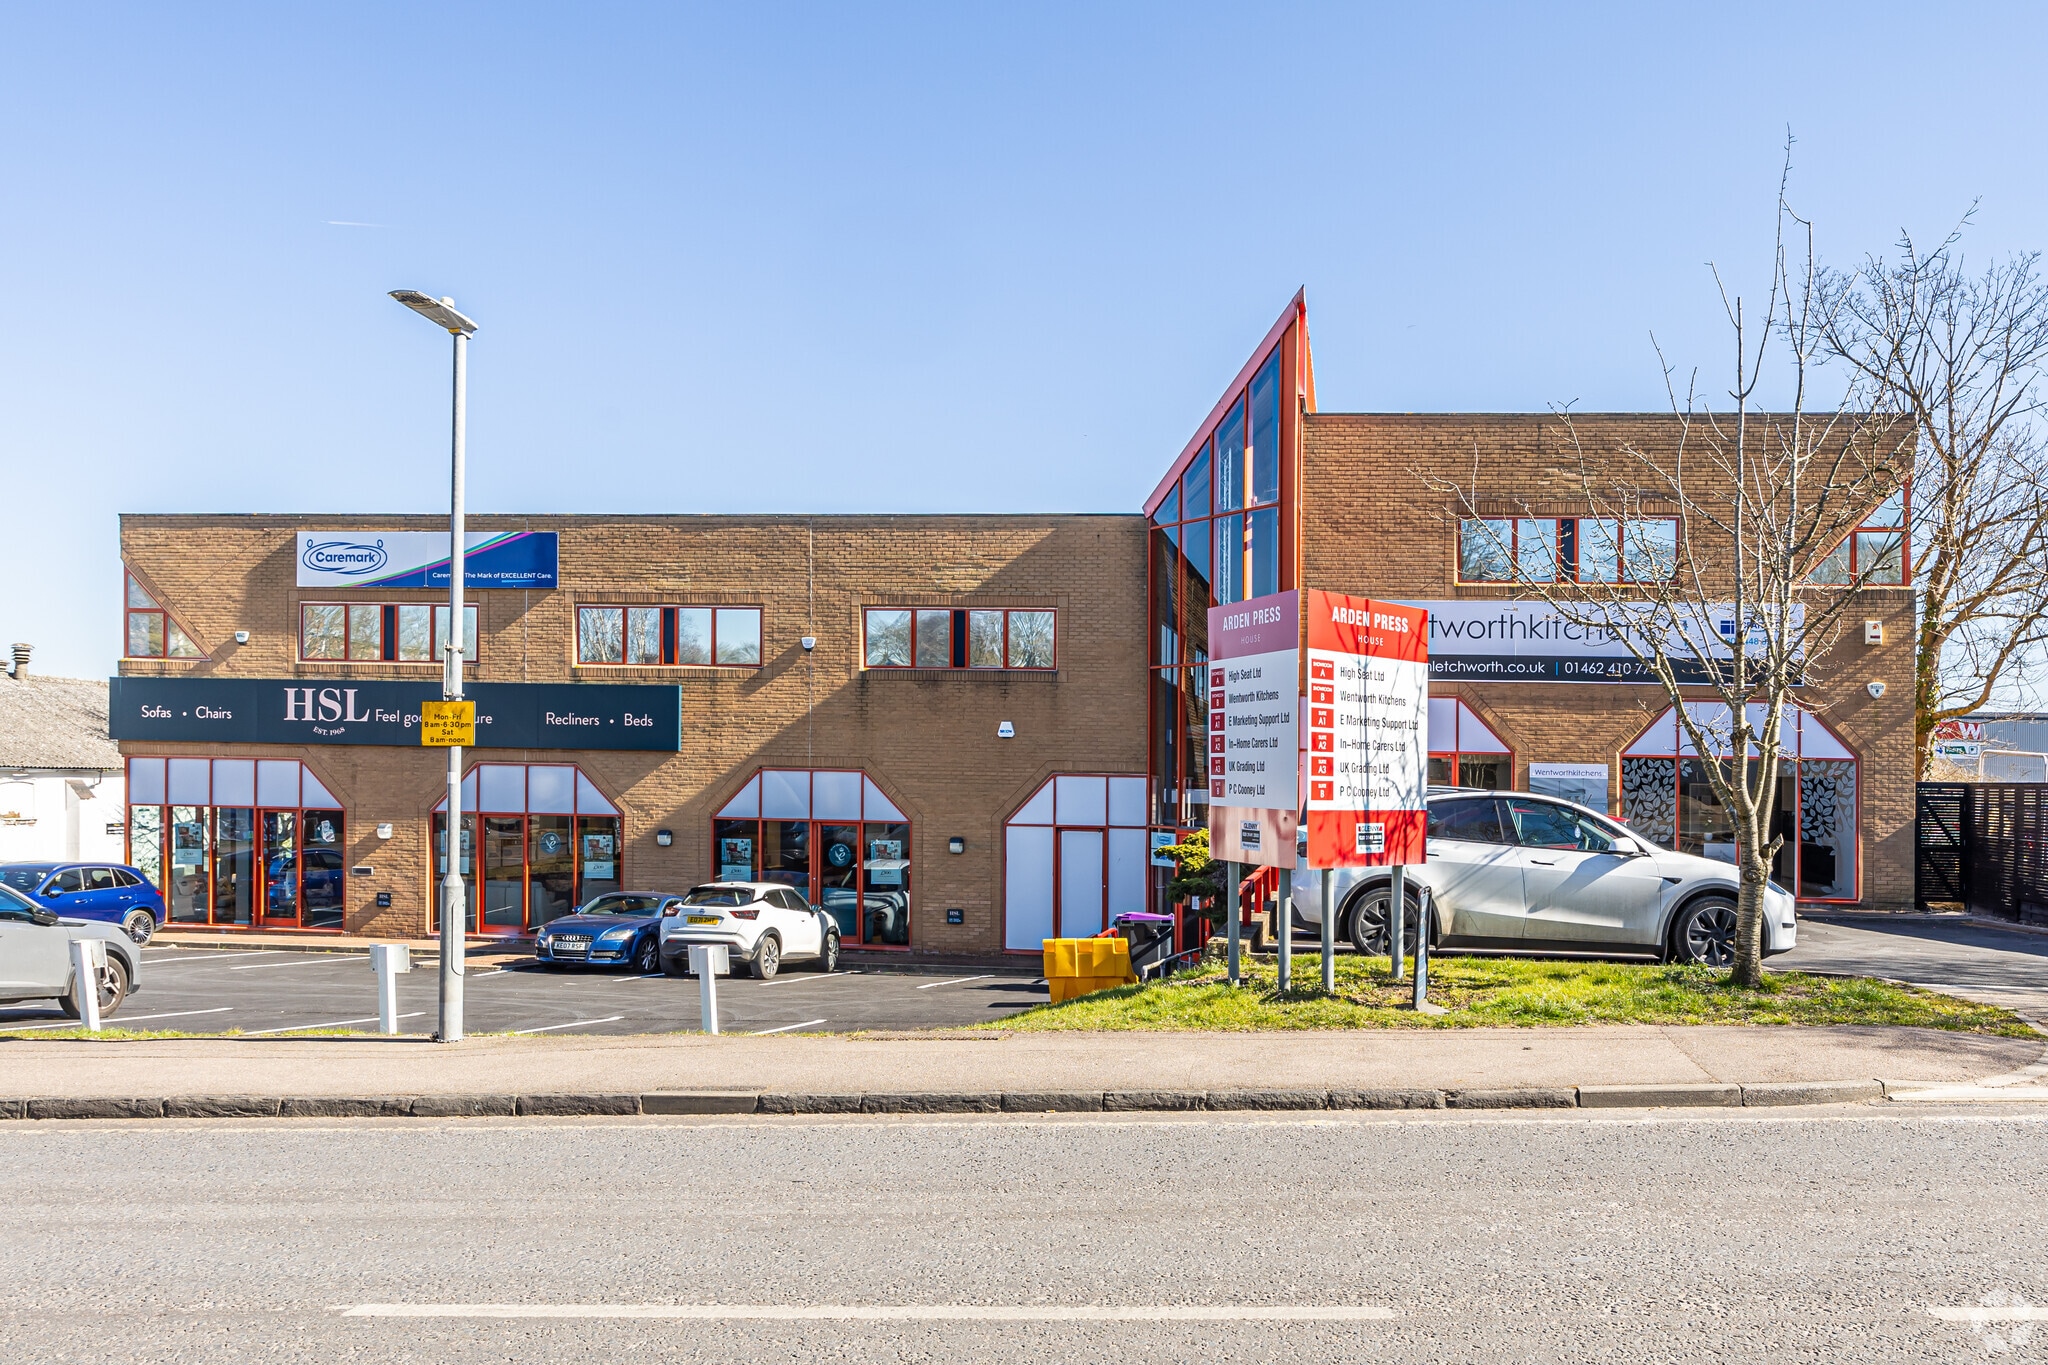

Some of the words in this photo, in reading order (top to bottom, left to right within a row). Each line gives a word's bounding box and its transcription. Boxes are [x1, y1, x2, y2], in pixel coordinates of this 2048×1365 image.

[316, 552, 375, 562] Caremark
[1223, 612, 1250, 631] ARDEN
[1253, 606, 1280, 626] PRESS
[1332, 606, 1370, 627] ARDEN
[1374, 613, 1408, 633] PRESS
[1241, 633, 1261, 644] HOUSE
[1358, 634, 1384, 646] HOUSE
[1320, 669, 1325, 677] A
[1340, 667, 1355, 680] High
[1358, 669, 1372, 680] Seat
[1374, 671, 1384, 681] Ltd
[1564, 662, 1604, 674] 01462
[1608, 662, 1631, 674] 410
[1229, 671, 1240, 683] High
[1241, 669, 1252, 680] Seat
[1253, 667, 1261, 678] Ltd
[1228, 692, 1255, 704] Wentworth
[1256, 690, 1279, 701] Kitchens
[1320, 693, 1325, 701] B
[1340, 691, 1376, 704] Wentworth
[1379, 694, 1406, 706] Kitchens
[284, 688, 370, 722] HSL
[141, 705, 172, 718] Sofas
[195, 706, 232, 719] Chairs
[375, 709, 400, 722] Feel
[546, 712, 600, 725] Recliners
[624, 713, 653, 726] Beds
[1229, 716, 1232, 726] E
[1233, 715, 1257, 727] Marketing
[1259, 713, 1280, 726] Support
[1281, 712, 1290, 723] Ltd
[1318, 717, 1326, 726] A1
[1340, 714, 1344, 725] E
[1346, 715, 1380, 729] Marketing
[1382, 717, 1407, 730] Support
[1409, 720, 1418, 730] Ltd
[313, 725, 328, 736] EST.
[330, 726, 345, 736] 1968
[1228, 738, 1250, 749] In-Home
[1252, 738, 1268, 748] Carers
[1270, 737, 1278, 748] Ltd
[1318, 741, 1326, 749] A2
[1340, 739, 1370, 750] In-Home
[1373, 740, 1394, 751] Carers
[1396, 741, 1406, 752] Ltd
[1229, 761, 1235, 772] UK
[1237, 761, 1255, 774] Grading
[1257, 761, 1265, 771] Ltd
[1318, 766, 1326, 774] A3
[1340, 762, 1349, 773] UK
[1352, 763, 1377, 776] Grading
[1379, 763, 1389, 774] Ltd
[1535, 769, 1602, 777] Wentworthkitchens
[1229, 784, 1232, 794] P
[1233, 784, 1237, 794] C
[1238, 784, 1256, 797] Cooney
[1257, 785, 1265, 795] Ltd
[1320, 790, 1324, 798] B
[1340, 786, 1344, 796] P
[1347, 786, 1351, 796] C
[1353, 786, 1377, 799] Cooney
[1379, 787, 1389, 797] Ltd
